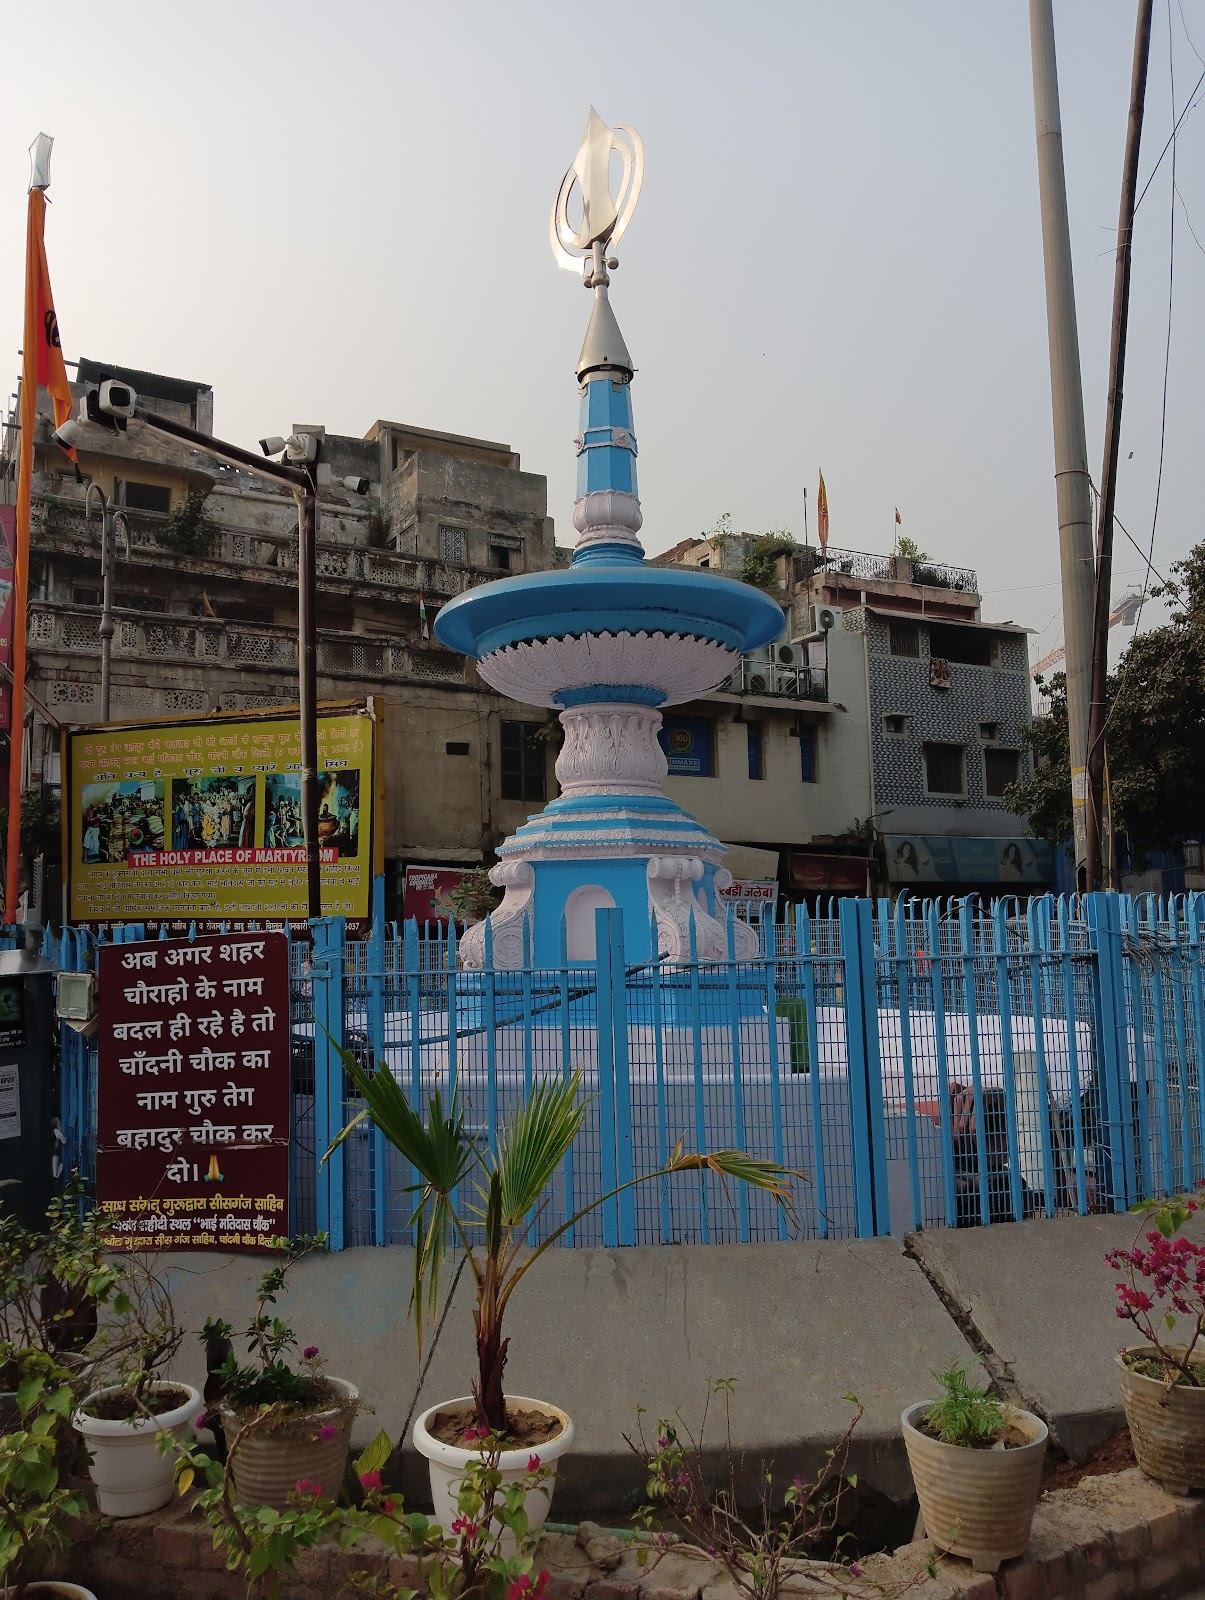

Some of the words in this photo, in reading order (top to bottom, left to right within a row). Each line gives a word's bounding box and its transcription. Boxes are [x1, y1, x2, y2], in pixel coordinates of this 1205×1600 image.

[671, 758, 699, 767] OMAXE
[133, 854, 157, 867] THE
[160, 851, 192, 865] HOLY
[194, 849, 233, 864] PLACE
[236, 850, 253, 863] OF
[255, 848, 334, 863] MARTYRM
[121, 950, 158, 970] अब
[164, 945, 213, 966] अगर
[219, 940, 265, 964] शहर
[123, 976, 189, 1006] चौराहो
[194, 974, 217, 1000] के
[222, 977, 265, 998] नाम
[112, 1021, 164, 1041] बदल
[168, 1012, 192, 1041] ही
[196, 1009, 225, 1038] रहे
[230, 1008, 246, 1037] है
[251, 1005, 277, 1032] तो
[118, 1048, 184, 1076] चाँदनी
[188, 1046, 236, 1072] चौक
[241, 1050, 271, 1070] का
[136, 1091, 178, 1111] नाम
[184, 1090, 217, 1115] गुरु
[222, 1081, 255, 1107] तेग
[115, 1126, 186, 1153] बहादुर
[189, 1118, 237, 1145] चौक
[242, 1124, 274, 1144] कर
[254, 1193, 284, 1212] साहिब
[169, 1219, 192, 1232] स्थल
[219, 1213, 252, 1231] मतिदास
[174, 1233, 190, 1245] गंज
